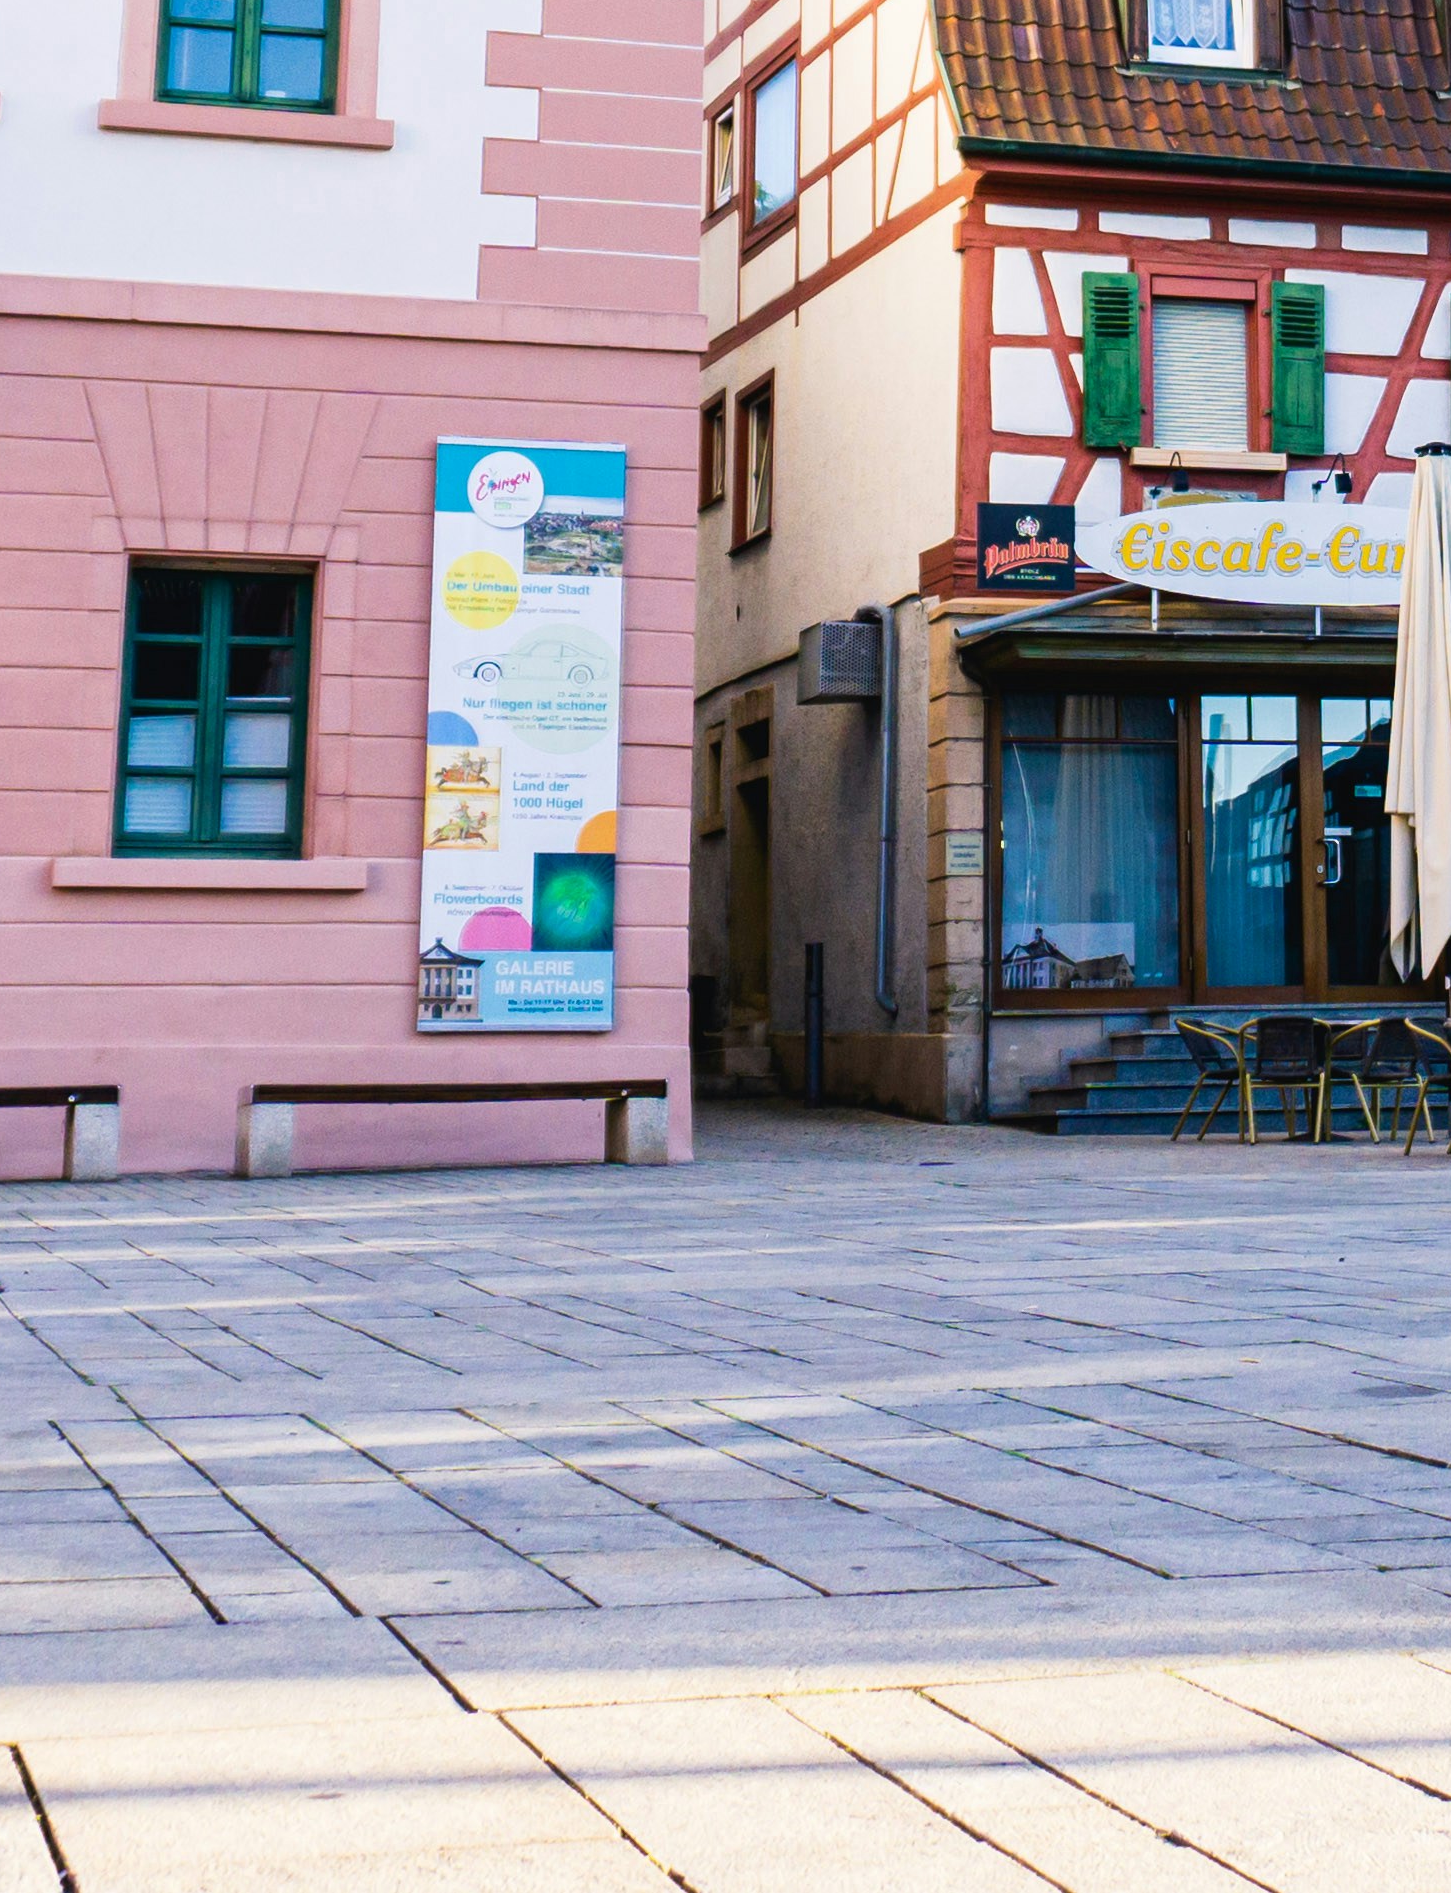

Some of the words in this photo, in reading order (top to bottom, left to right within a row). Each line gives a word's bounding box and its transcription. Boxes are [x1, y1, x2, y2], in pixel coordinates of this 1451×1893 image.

[983, 536, 1069, 579] Palmbräu
[447, 581, 468, 591] Der
[473, 581, 517, 593] Umbau
[522, 583, 553, 594] einer
[557, 584, 590, 595] Stadt
[463, 698, 486, 708] Nur
[490, 698, 533, 711] fliegen
[537, 699, 552, 710] ist
[513, 780, 545, 791] Land
[549, 781, 570, 791] der
[513, 797, 542, 808] 1000
[546, 797, 583, 811] Hügel
[434, 893, 523, 905] Flowerboards
[495, 960, 574, 976] GALERIE
[495, 980, 515, 994] IM
[520, 979, 605, 994] RATHAUS
